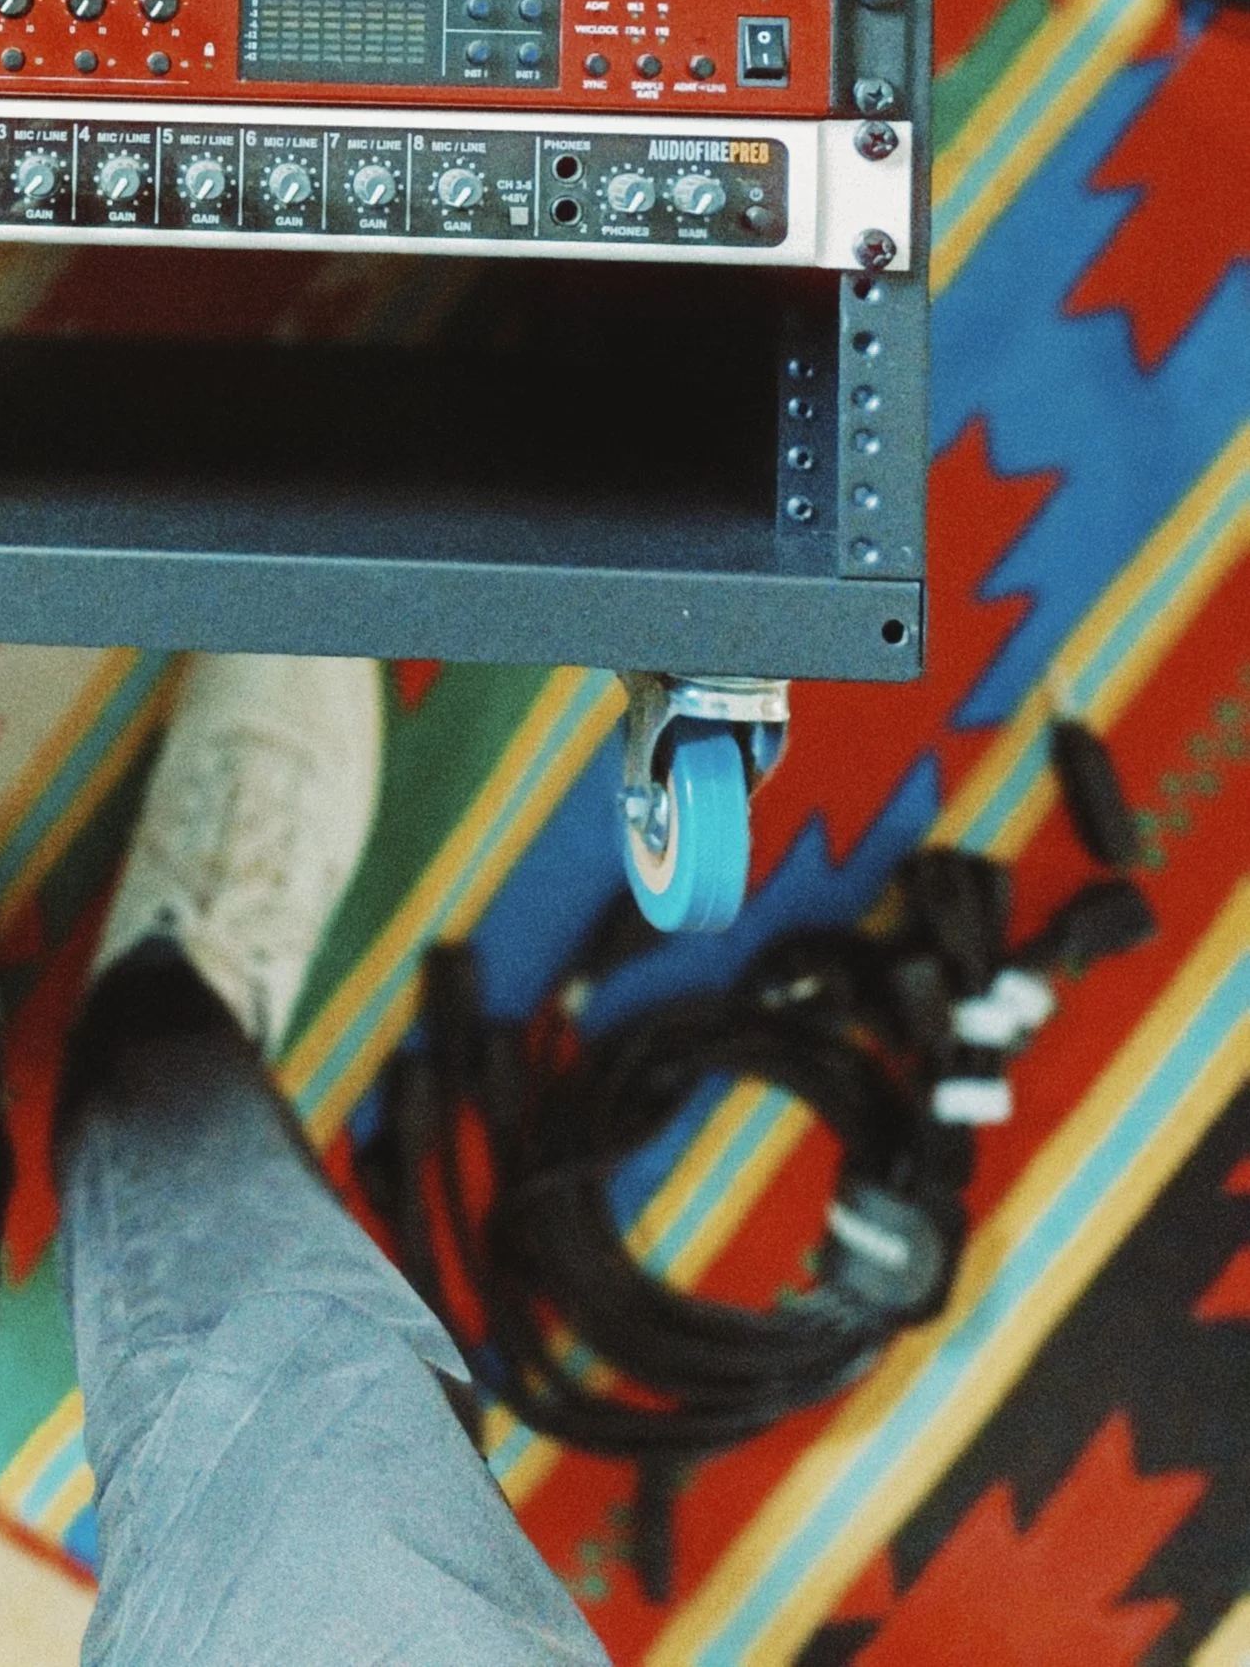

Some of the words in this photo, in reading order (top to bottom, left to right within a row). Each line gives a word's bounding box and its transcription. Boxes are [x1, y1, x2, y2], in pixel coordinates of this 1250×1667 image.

[582, 80, 607, 89] SYNC
[14, 130, 34, 141] MIC
[43, 131, 67, 142] LINE
[79, 126, 90, 142] 4
[97, 133, 117, 143] MIC
[125, 133, 150, 144] LINE
[163, 128, 173, 144] 5
[246, 131, 256, 146] 6
[180, 135, 201, 145] MIC
[209, 135, 234, 146] LINE
[264, 137, 284, 147] MIC
[292, 138, 318, 148] LINE
[330, 133, 340, 148] 7
[348, 139, 368, 149] MIC
[376, 140, 402, 150] LINE
[413, 135, 424, 150] 8
[544, 140, 591, 151] PHONES
[431, 141, 452, 152] MIC
[461, 142, 486, 153] LINE
[497, 180, 513, 190] CH
[501, 194, 528, 203] +48V
[25, 209, 53, 219] GAIN
[109, 211, 136, 222] GAIN
[192, 214, 219, 224] GAIN
[275, 216, 303, 227] GAIN
[359, 218, 387, 229] GAIN
[444, 221, 471, 232] GAIN
[580, 224, 587, 233] 2
[602, 226, 649, 237] PHONES
[678, 228, 708, 238] MAIN
